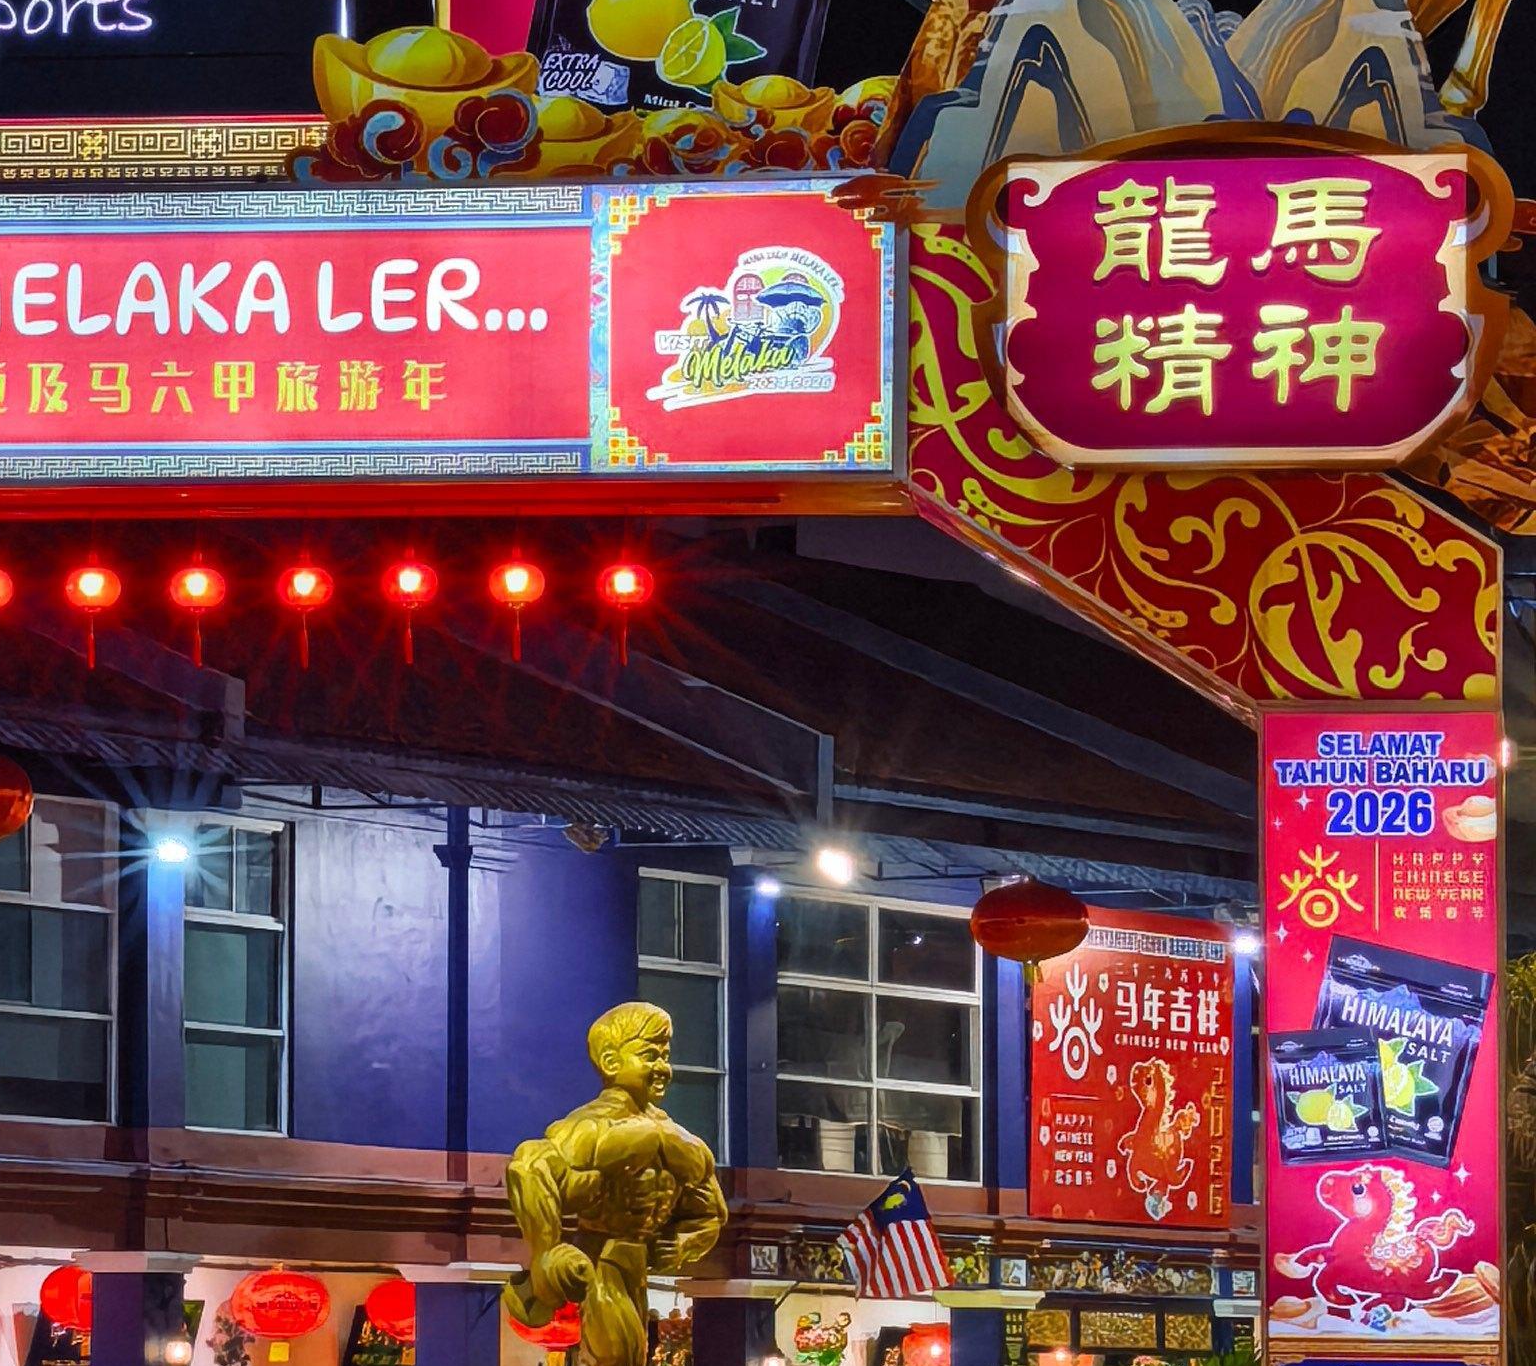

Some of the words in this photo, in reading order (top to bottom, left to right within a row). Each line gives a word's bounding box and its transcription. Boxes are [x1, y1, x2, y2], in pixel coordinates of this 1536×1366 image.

[543, 52, 601, 71] EXTRA
[545, 70, 595, 89] COOL
[1092, 175, 1383, 287] 龍馬
[681, 338, 794, 388] Melaka
[1090, 303, 1386, 417] 精神
[1318, 732, 1443, 756] SELAMAT
[1275, 761, 1365, 784] TAHUN
[1375, 761, 1486, 784] BAHARU
[1327, 789, 1433, 834] 2026
[1392, 870, 1484, 884] CHINESE
[1114, 980, 1221, 1037] 马年吉祥
[1341, 995, 1455, 1048] HIMALAYA
[1114, 1033, 1161, 1049] CHINESE
[1166, 1038, 1189, 1052] NEW
[1406, 1041, 1452, 1064] SALT
[1289, 1061, 1367, 1086] HIMALAYA
[1338, 1081, 1367, 1094] SALT
